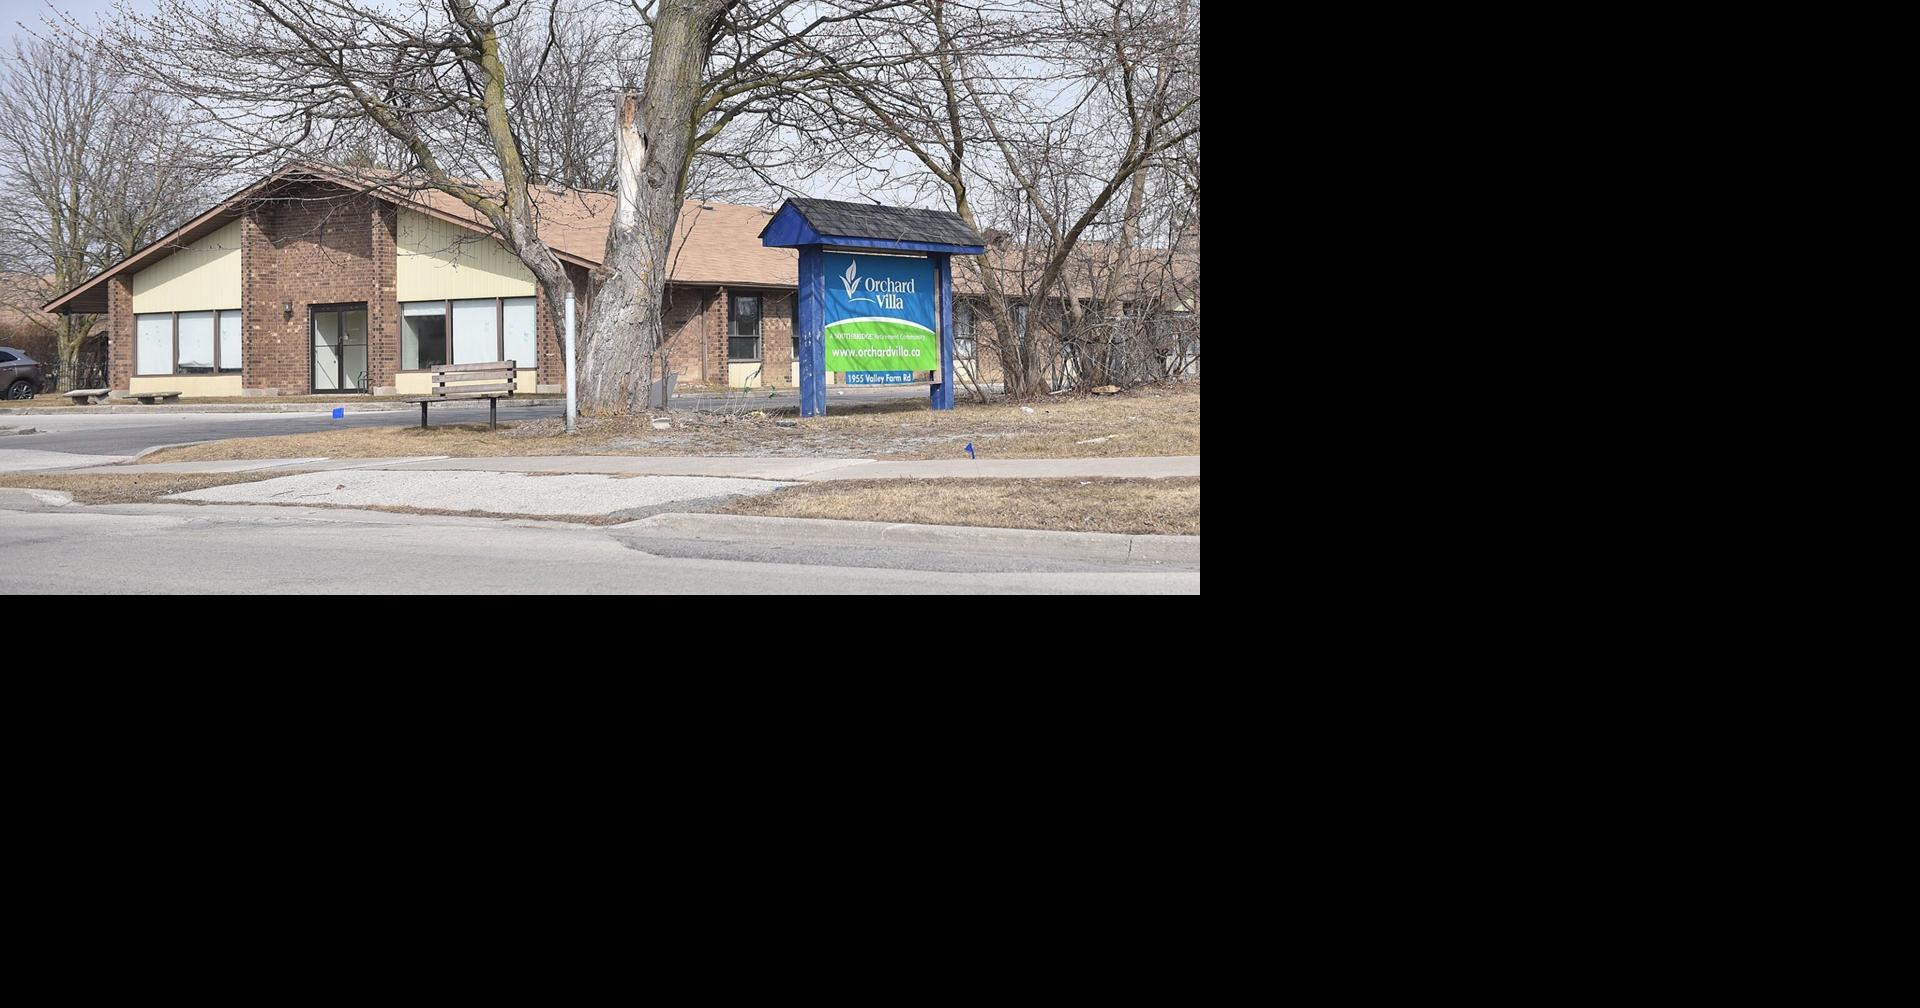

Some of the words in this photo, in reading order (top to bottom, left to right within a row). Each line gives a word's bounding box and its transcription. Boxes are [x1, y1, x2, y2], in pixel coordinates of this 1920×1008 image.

[865, 277, 915, 294] Orchard
[876, 294, 904, 310] Villa
[832, 345, 921, 357] www.orchardvilla.ca
[848, 374, 864, 383] 1955
[865, 374, 884, 384] Valley
[886, 373, 902, 382] Farm
[903, 373, 911, 382] Rd
